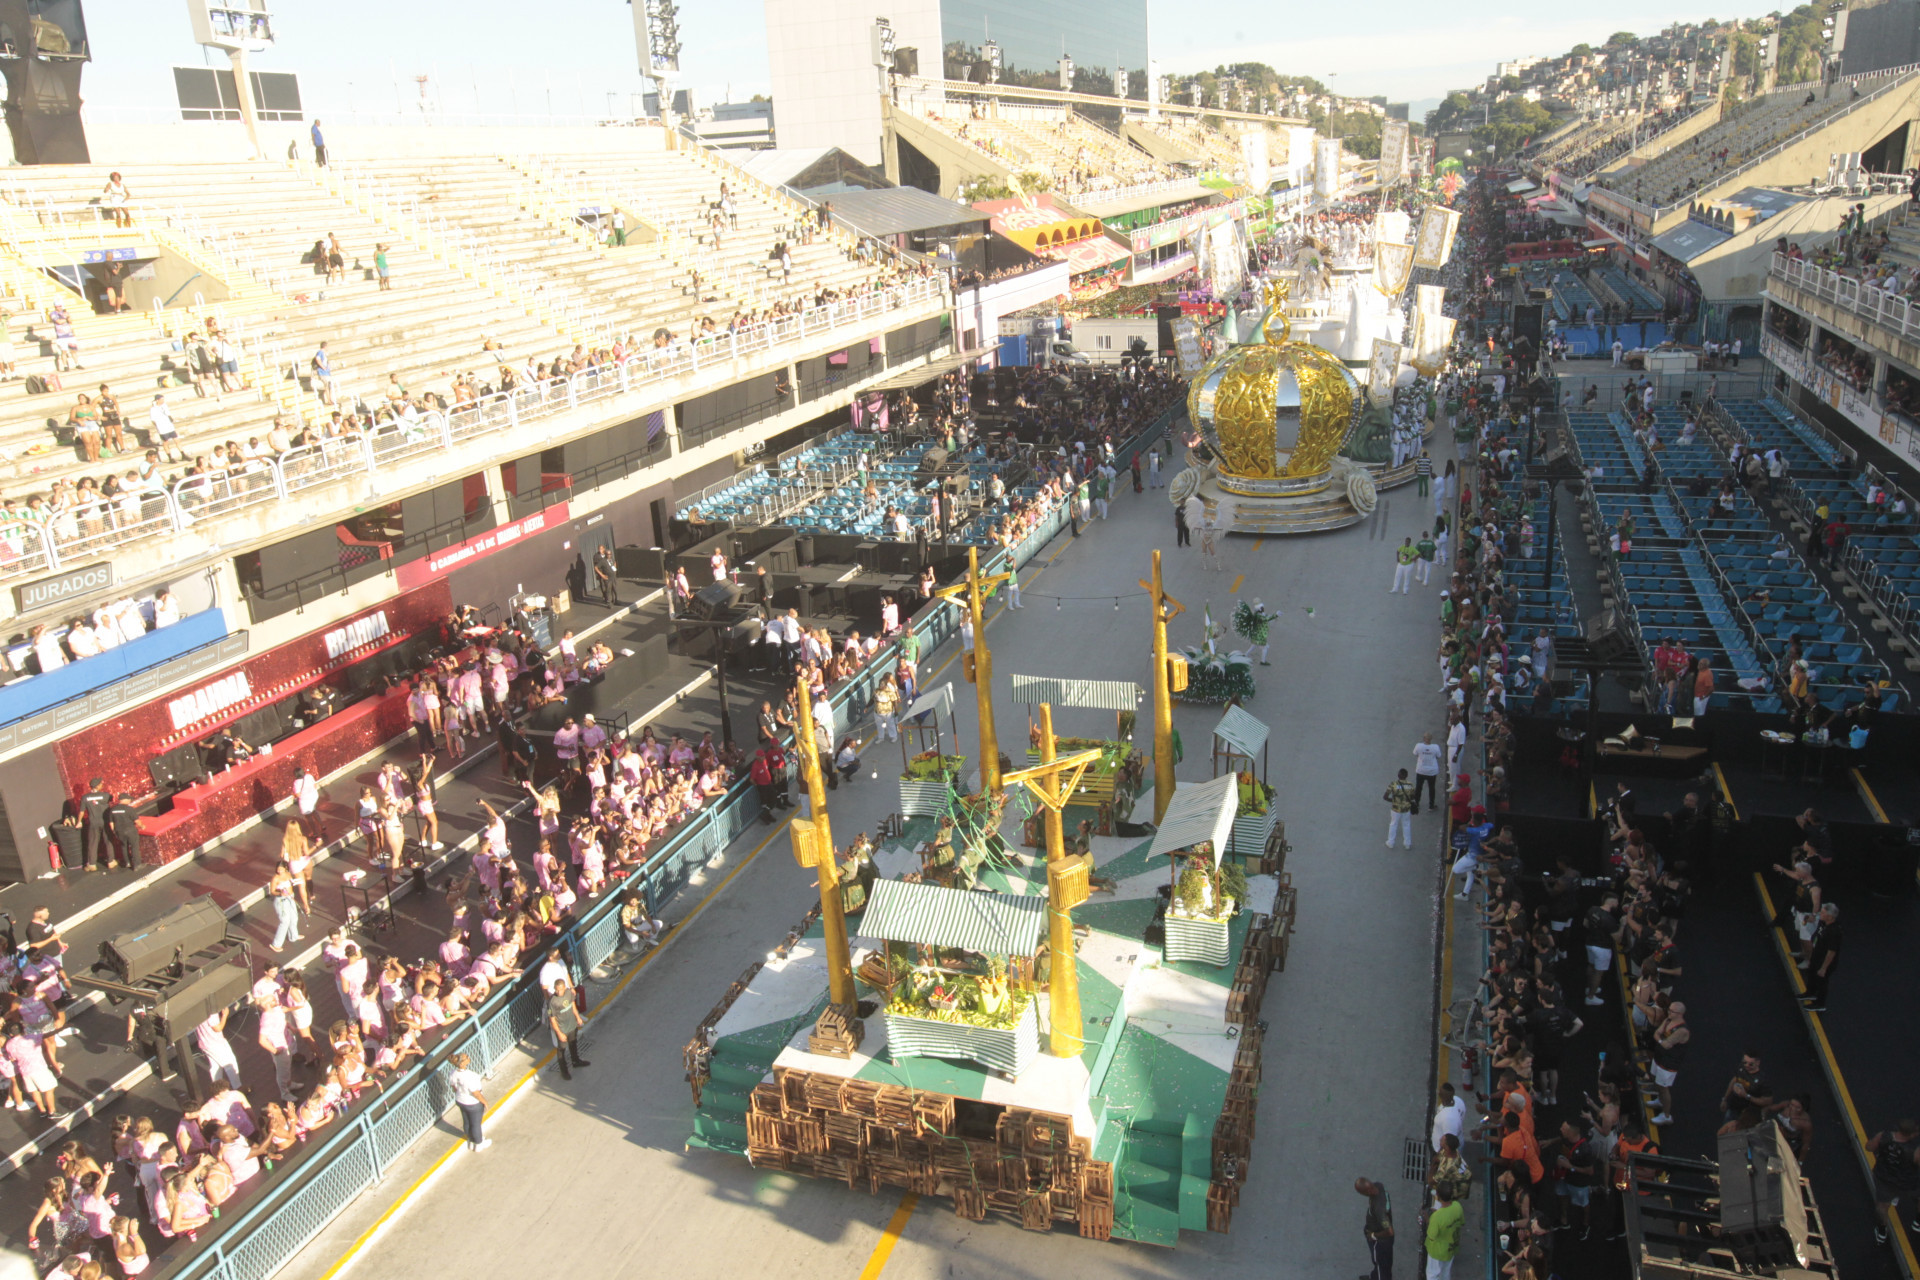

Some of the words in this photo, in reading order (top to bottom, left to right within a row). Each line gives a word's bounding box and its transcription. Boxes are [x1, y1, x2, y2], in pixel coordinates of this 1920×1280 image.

[430, 561, 437, 572] O
[437, 546, 476, 569] CARNAVAL
[475, 539, 485, 553] TÁ
[485, 536, 496, 548] DE
[497, 524, 521, 545] BRAHMAS
[25, 569, 107, 605] JURADOS
[324, 610, 391, 659] BRAHMA
[168, 671, 252, 730] BRAHMA
[22, 720, 49, 734] BATERIA
